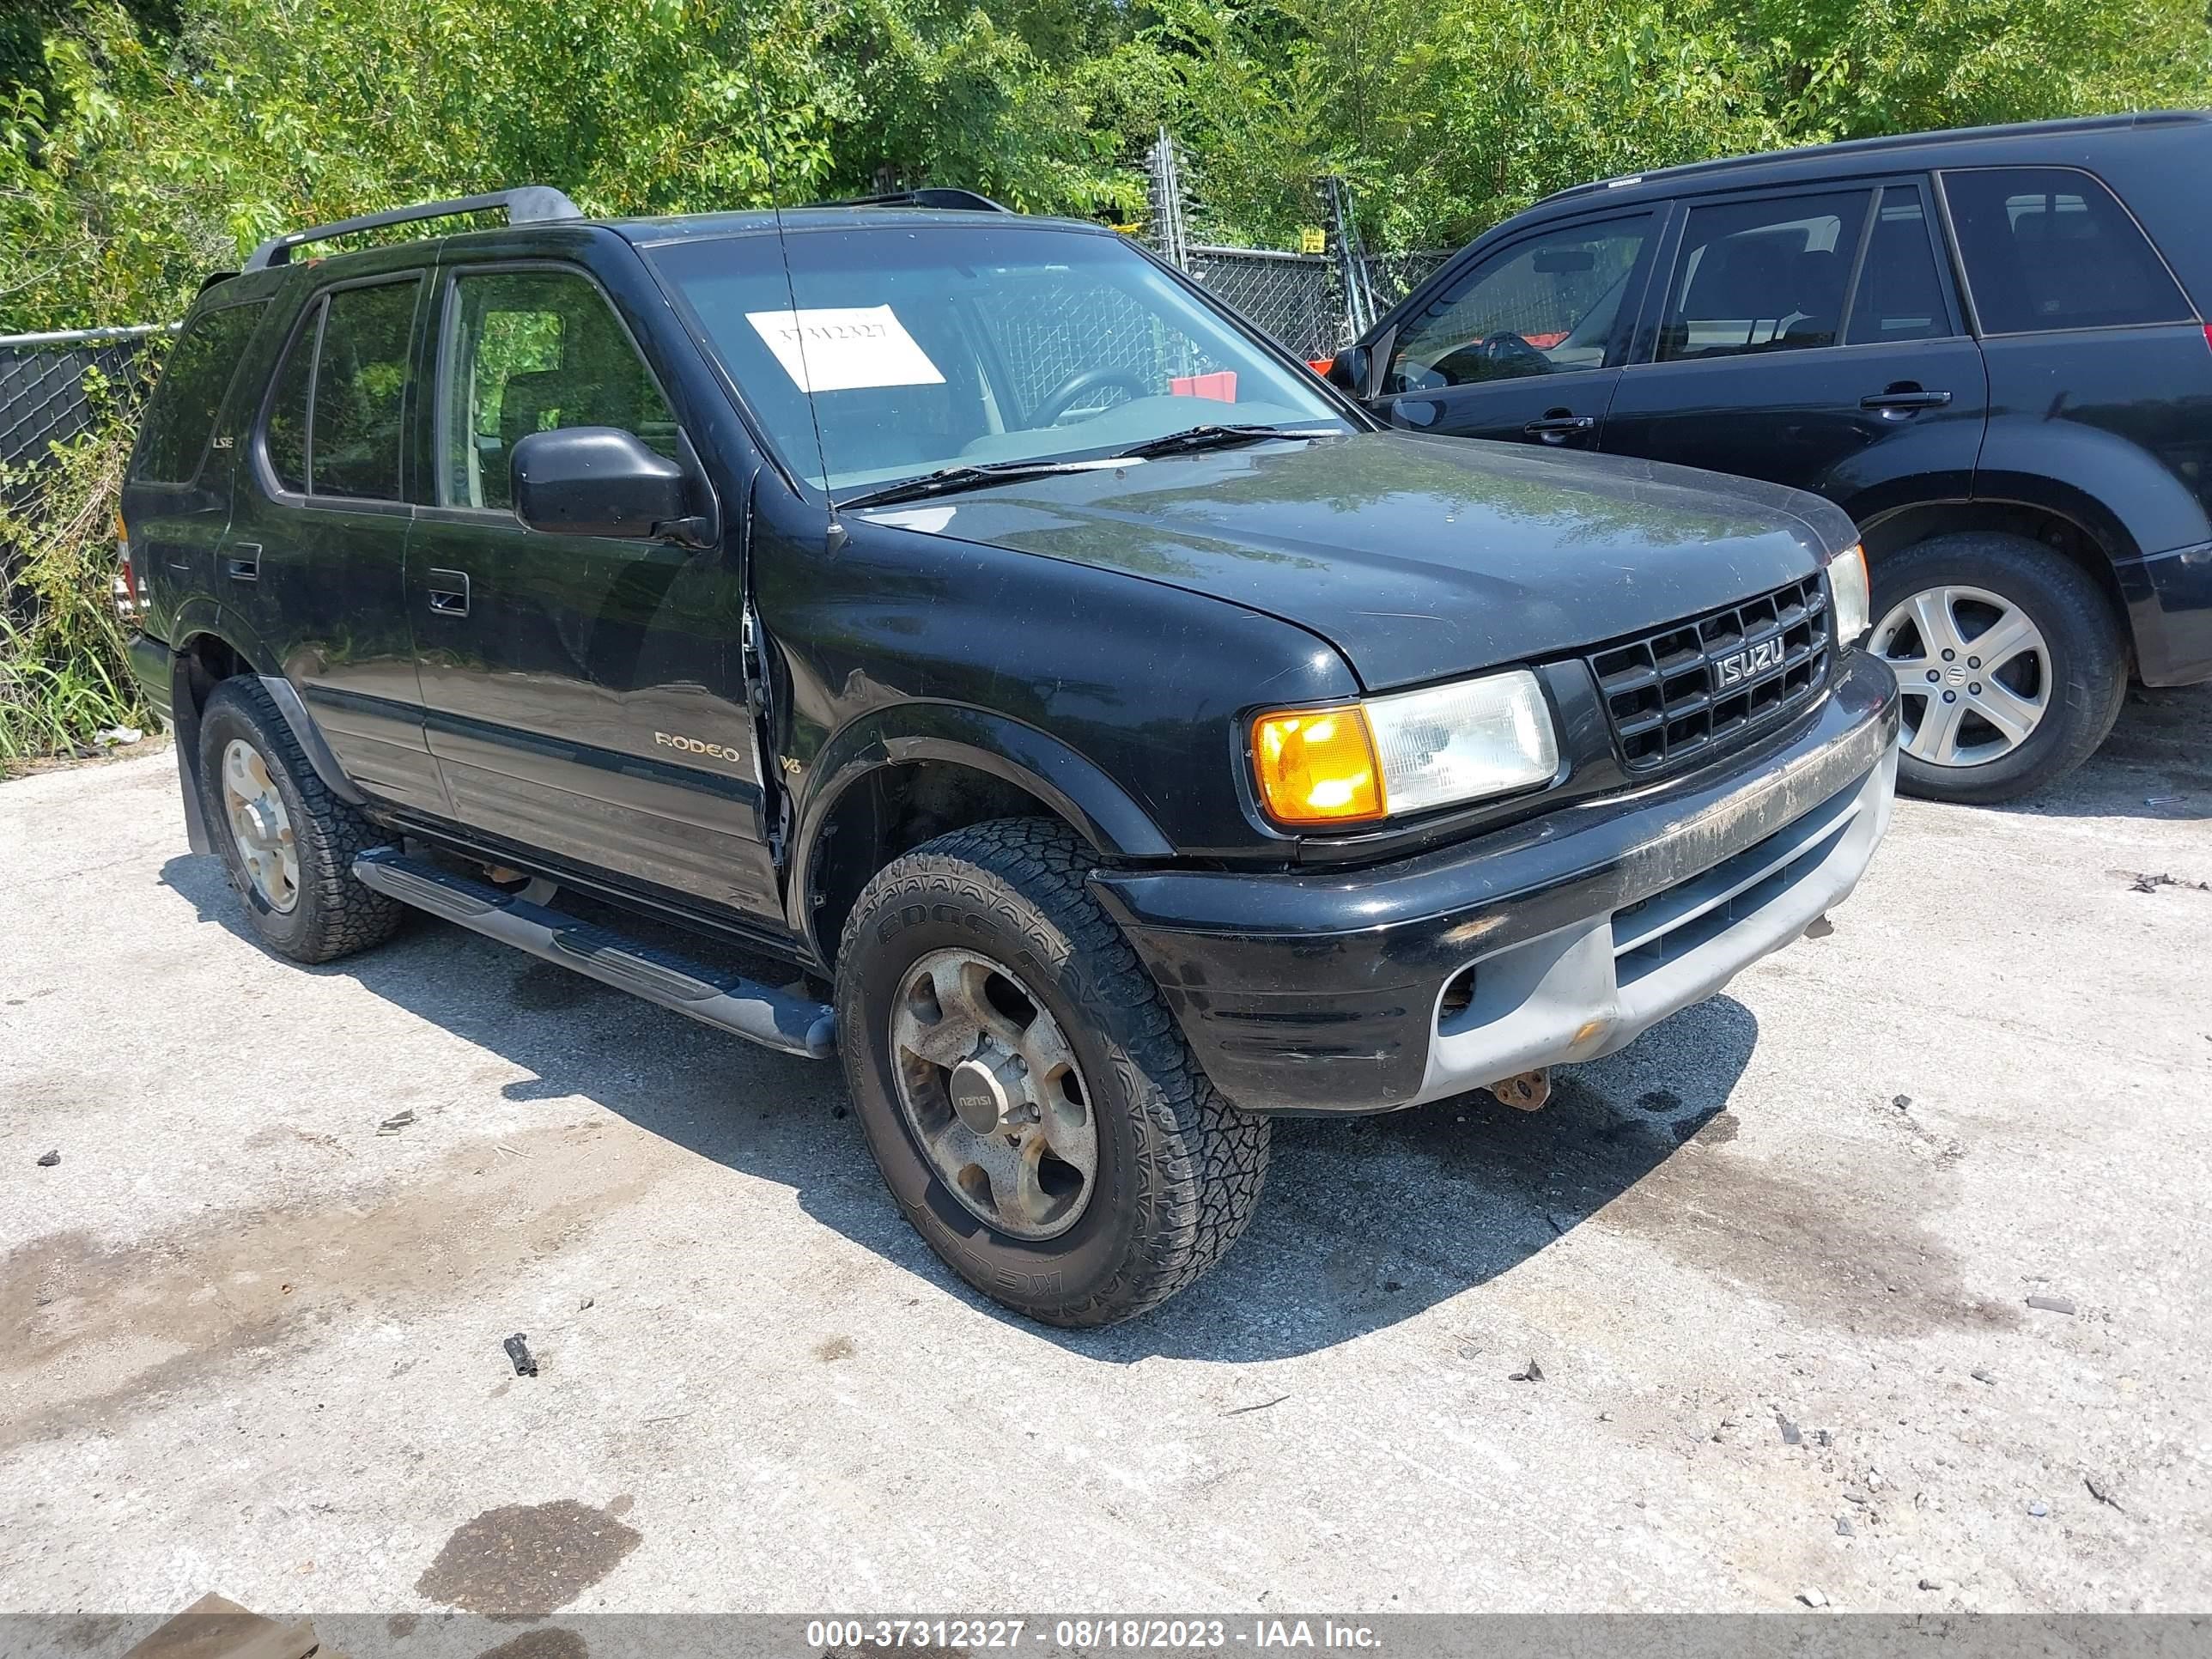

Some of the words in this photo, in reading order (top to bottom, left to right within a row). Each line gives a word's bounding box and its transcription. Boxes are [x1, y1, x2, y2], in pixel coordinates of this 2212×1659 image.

[778, 324, 886, 343] 37312327
[1715, 636, 1785, 688] ISUZU
[654, 731, 741, 763] RODEO
[779, 755, 802, 774] V6
[958, 1095, 992, 1107] ISUZU
[903, 1198, 1063, 1298] KELLY
